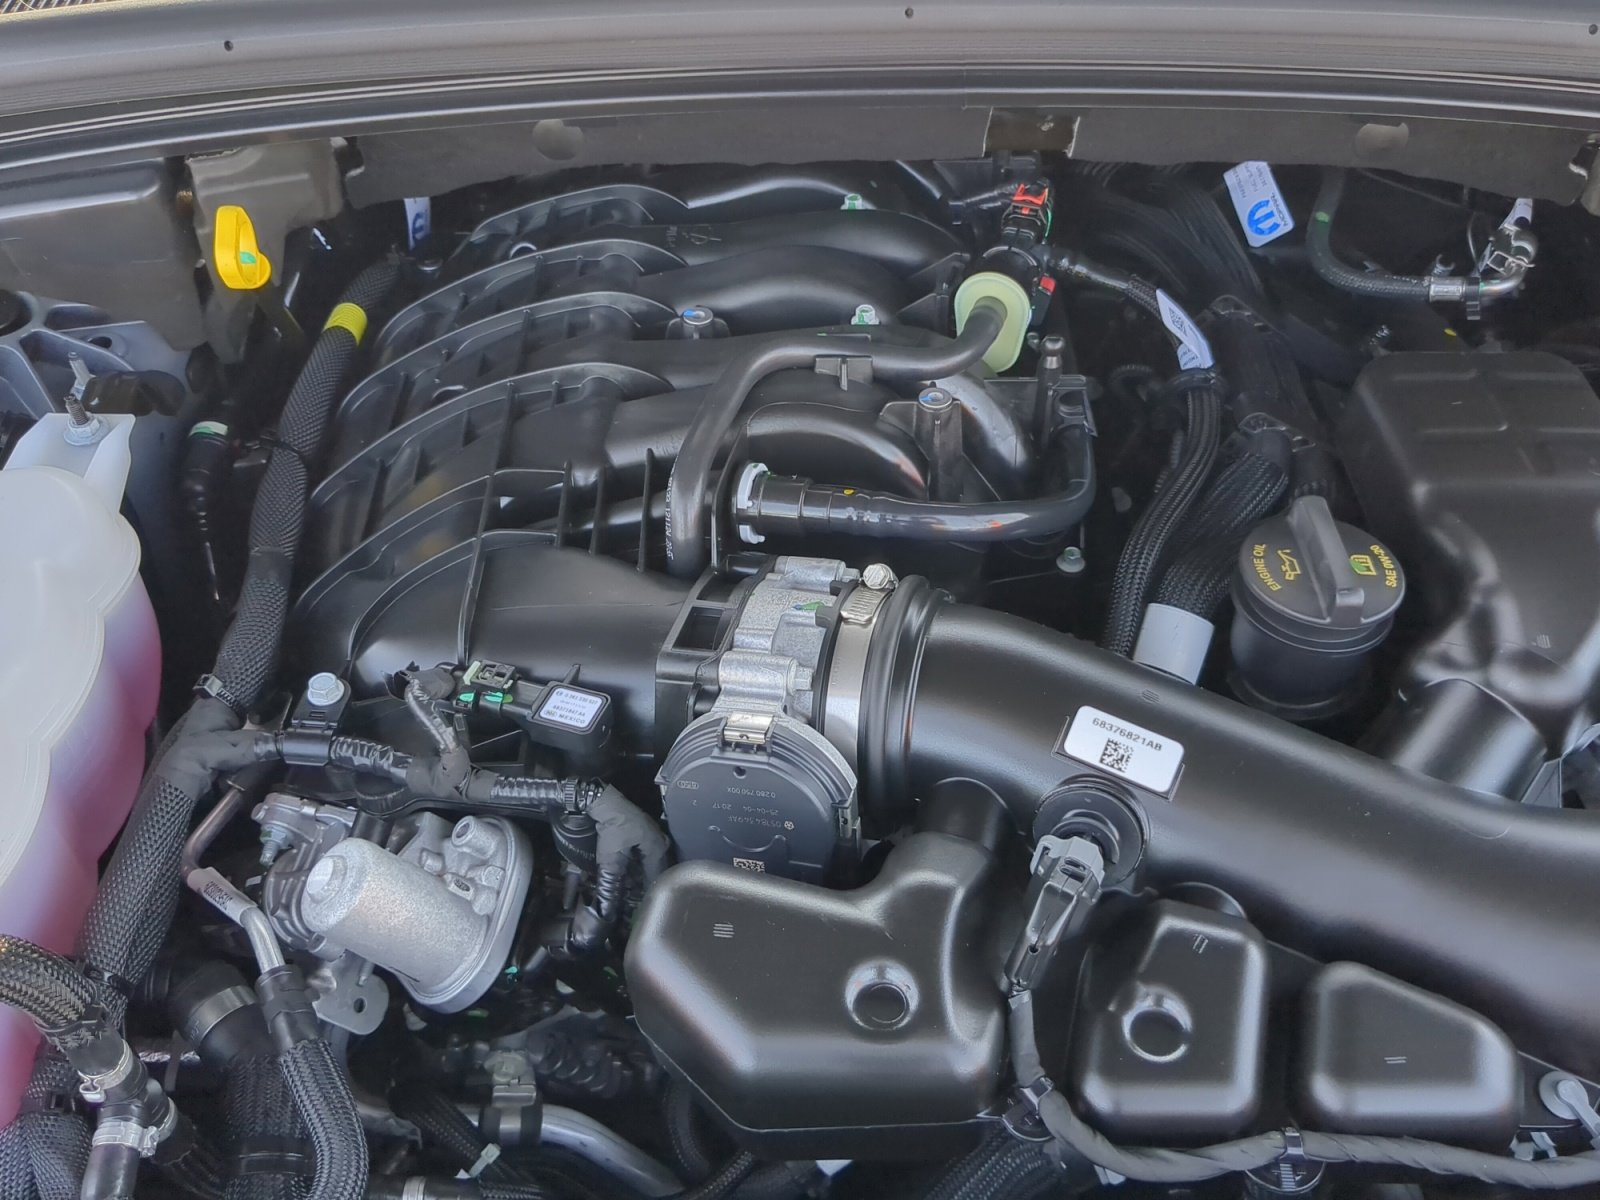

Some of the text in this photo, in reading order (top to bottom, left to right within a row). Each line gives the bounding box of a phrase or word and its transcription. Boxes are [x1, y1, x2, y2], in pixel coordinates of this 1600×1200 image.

[1253, 544, 1282, 591] ENGINE OIL
[1369, 544, 1397, 587] SAE 0W-20
[558, 713, 586, 724] MEXICO
[1092, 717, 1163, 751] 68376821AB
